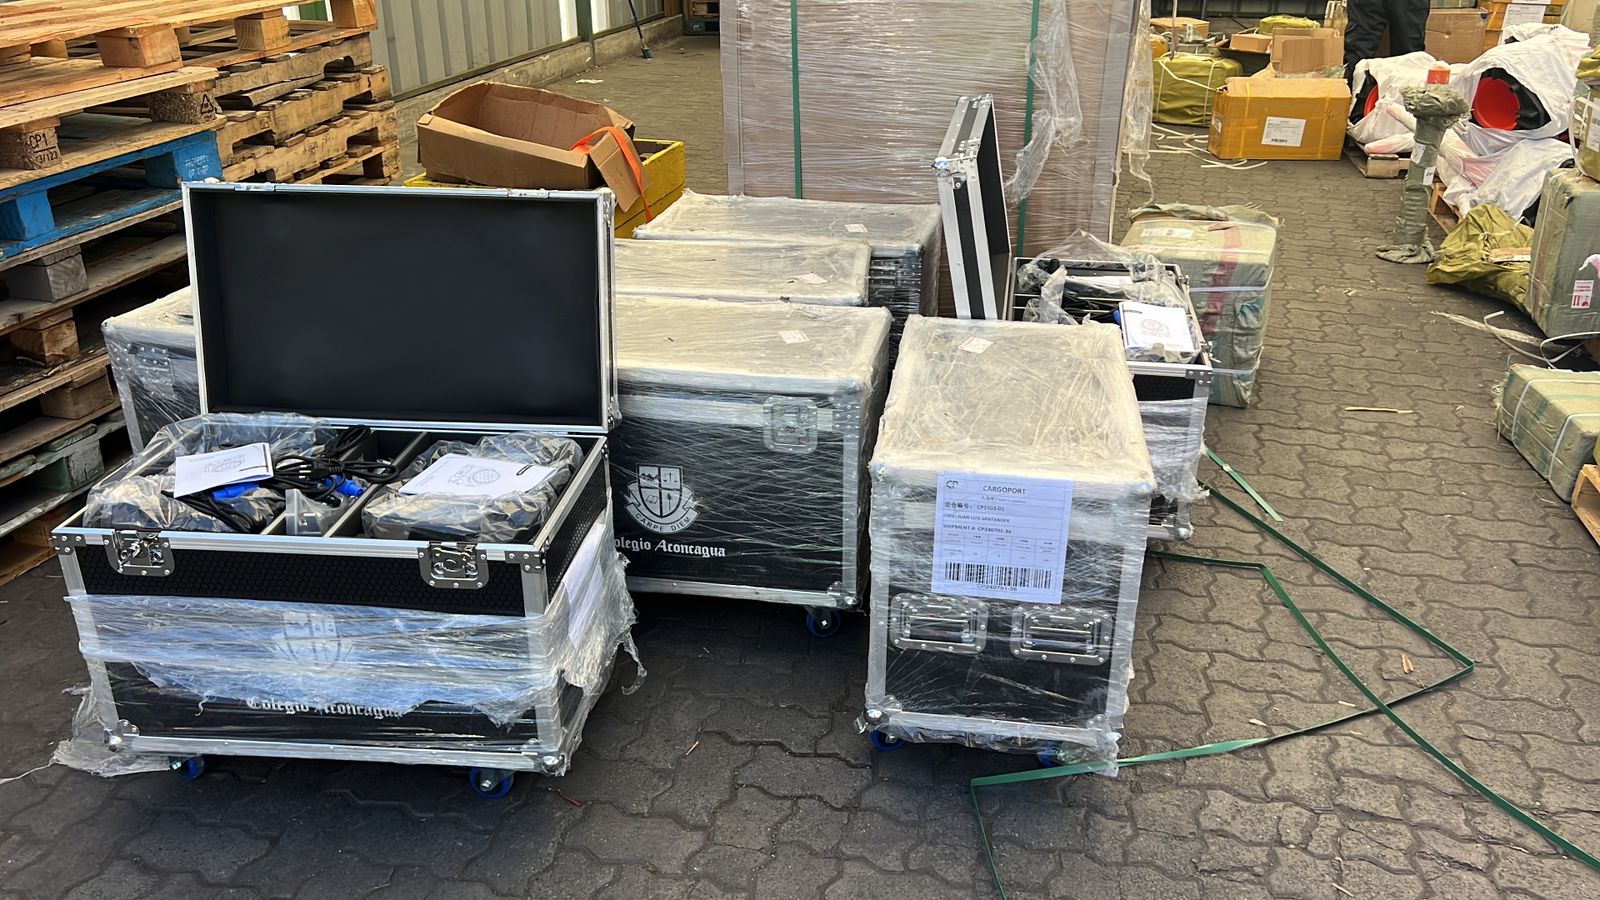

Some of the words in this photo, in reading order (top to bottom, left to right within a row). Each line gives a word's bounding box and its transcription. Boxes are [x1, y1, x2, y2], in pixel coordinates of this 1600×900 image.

[29, 133, 48, 149] CP1
[983, 485, 1027, 494] CARGOPORT
[635, 512, 664, 532] CARPE
[670, 516, 691, 532] DIEM
[977, 526, 1012, 534] CP240701-36
[614, 537, 651, 552] olegio
[655, 539, 726, 558] Aconcagua
[977, 583, 1018, 592] CP240701-36
